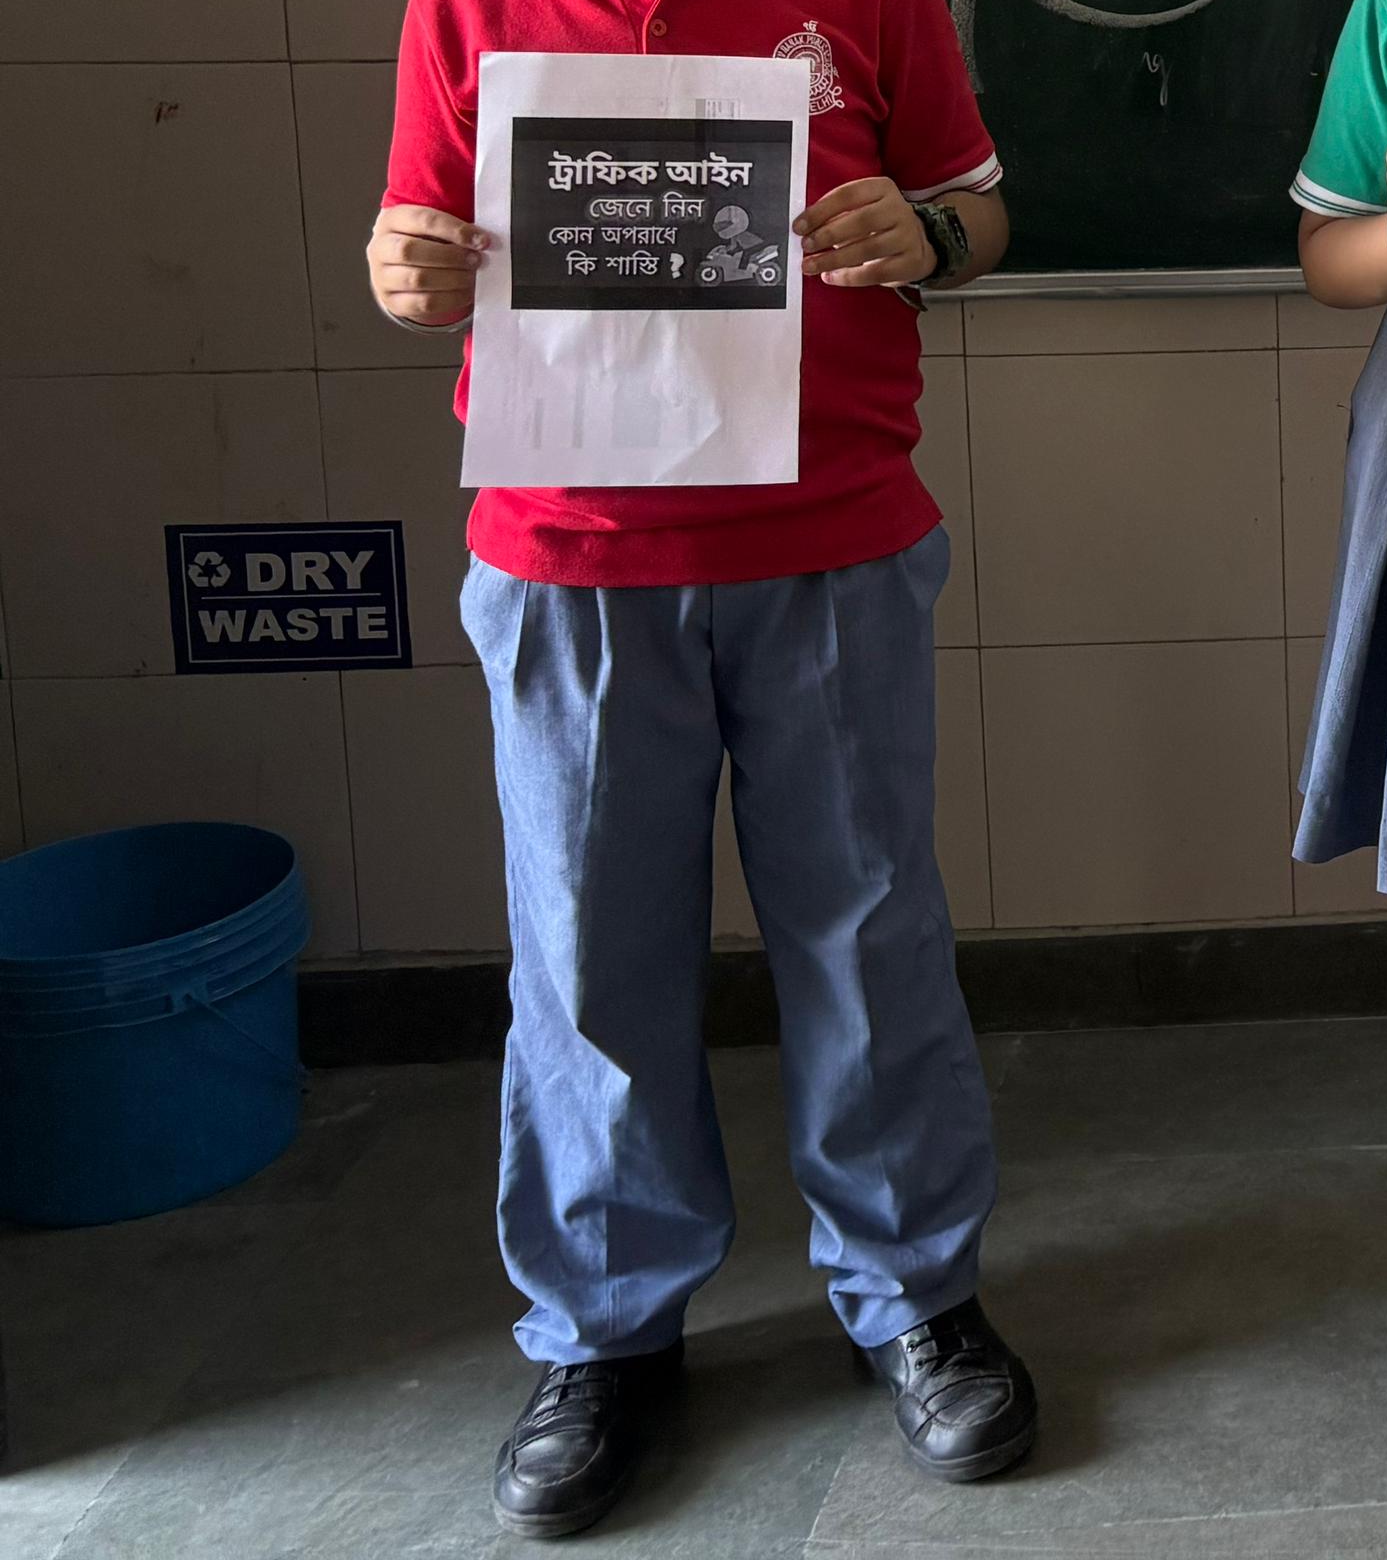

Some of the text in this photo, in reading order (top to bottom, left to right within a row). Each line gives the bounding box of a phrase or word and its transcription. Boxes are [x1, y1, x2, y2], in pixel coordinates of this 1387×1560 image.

[809, 94, 833, 112] ELHI
[547, 150, 754, 191] ট্রাফিক আইন
[589, 191, 705, 219] জেনে নিন
[549, 226, 679, 246] কোন অপরাধে
[565, 249, 598, 276] কি
[605, 249, 660, 276] শাস্তি
[245, 550, 376, 592] DRY
[198, 607, 389, 643] WASTE
